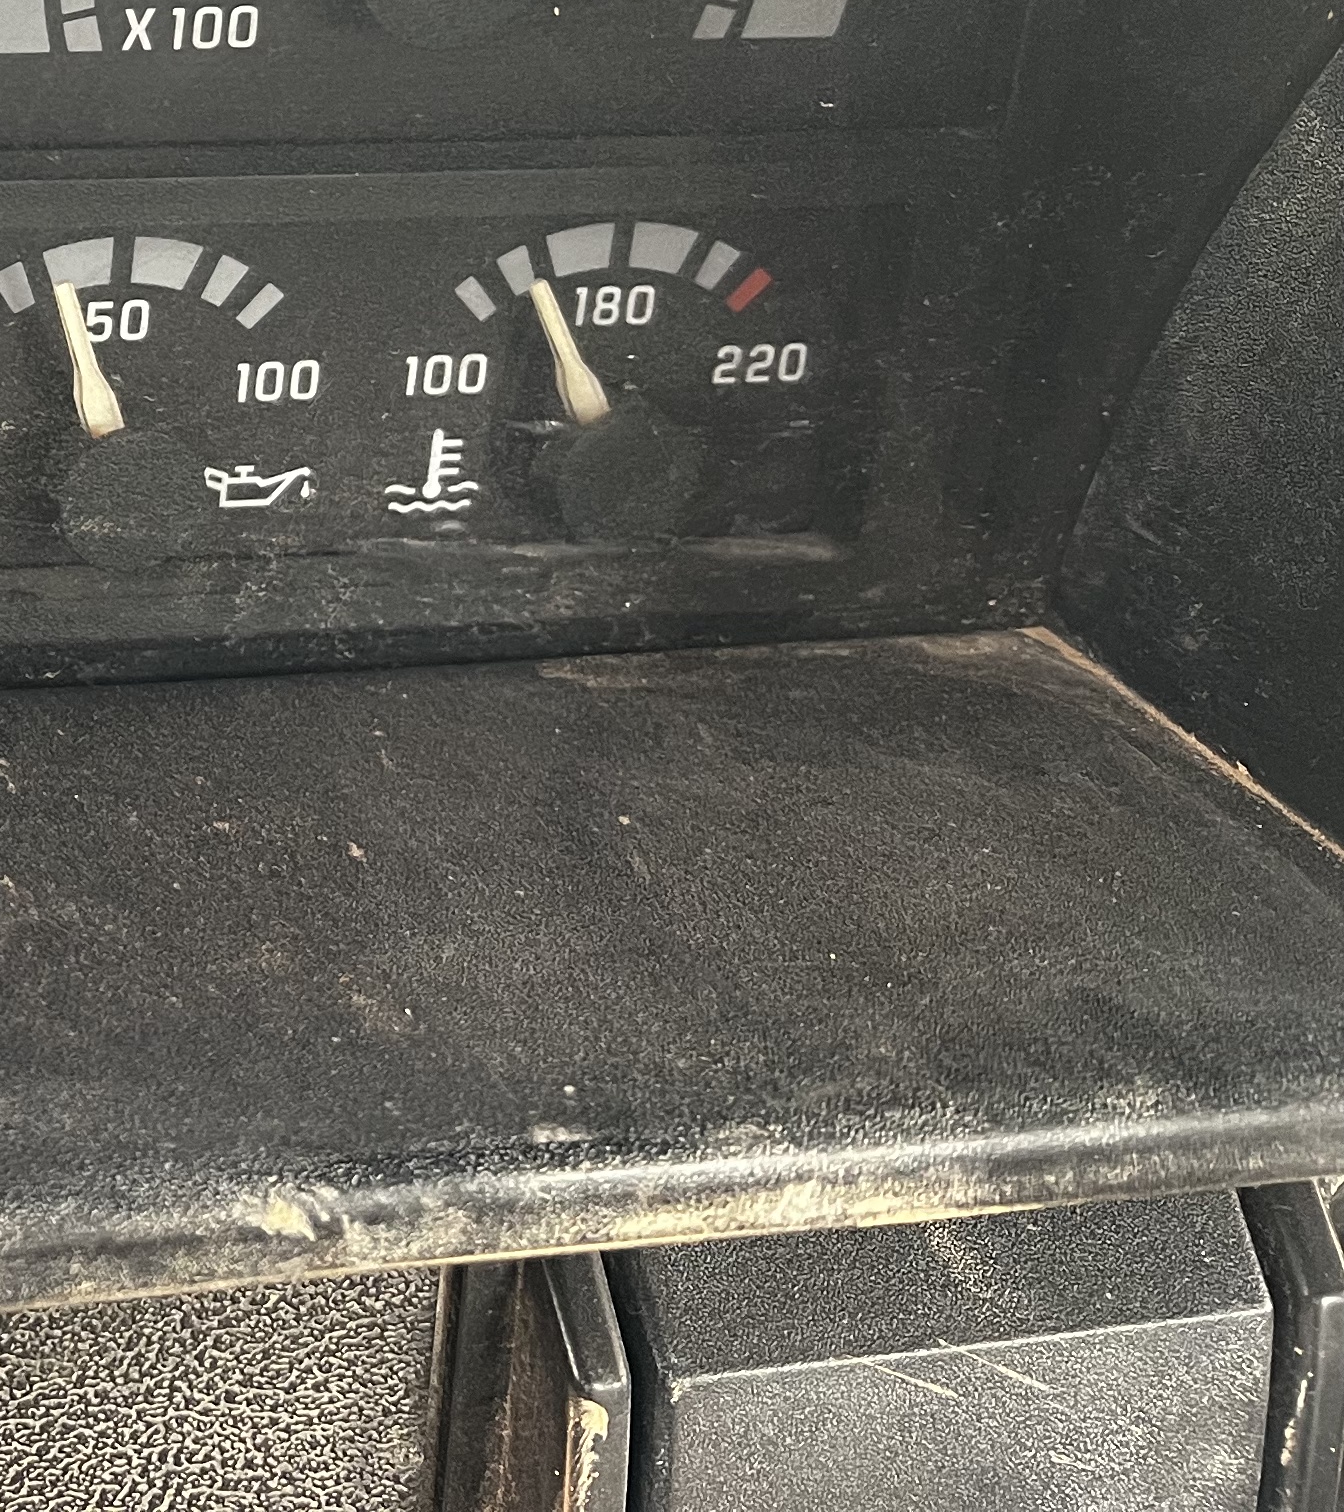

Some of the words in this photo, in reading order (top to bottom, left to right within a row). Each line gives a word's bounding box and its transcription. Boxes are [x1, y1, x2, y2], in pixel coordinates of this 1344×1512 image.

[86, 299, 150, 342] 50
[574, 285, 656, 326] 180
[236, 359, 320, 403] 100
[404, 353, 488, 396] 100
[712, 342, 808, 384] 220
